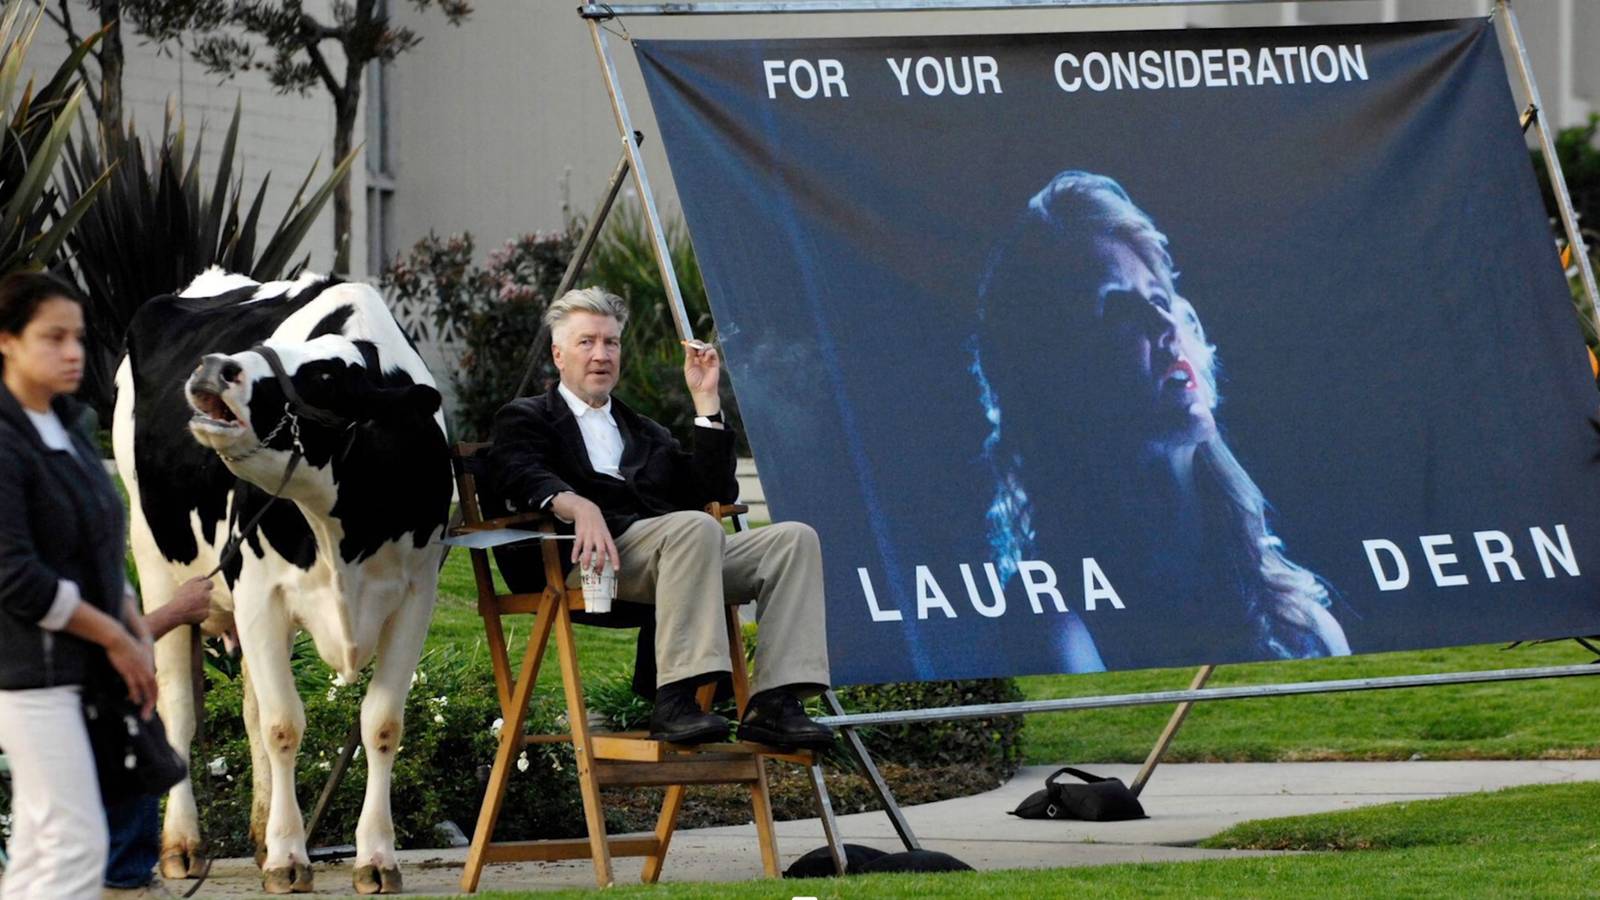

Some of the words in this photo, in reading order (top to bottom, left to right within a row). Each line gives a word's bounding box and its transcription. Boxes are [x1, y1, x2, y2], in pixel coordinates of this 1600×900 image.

[763, 58, 849, 99] FOR
[886, 55, 1003, 96] YOUR
[1054, 43, 1370, 92] CONSIDERATION
[857, 557, 1126, 622] LAURA
[1362, 523, 1582, 591] DERN
